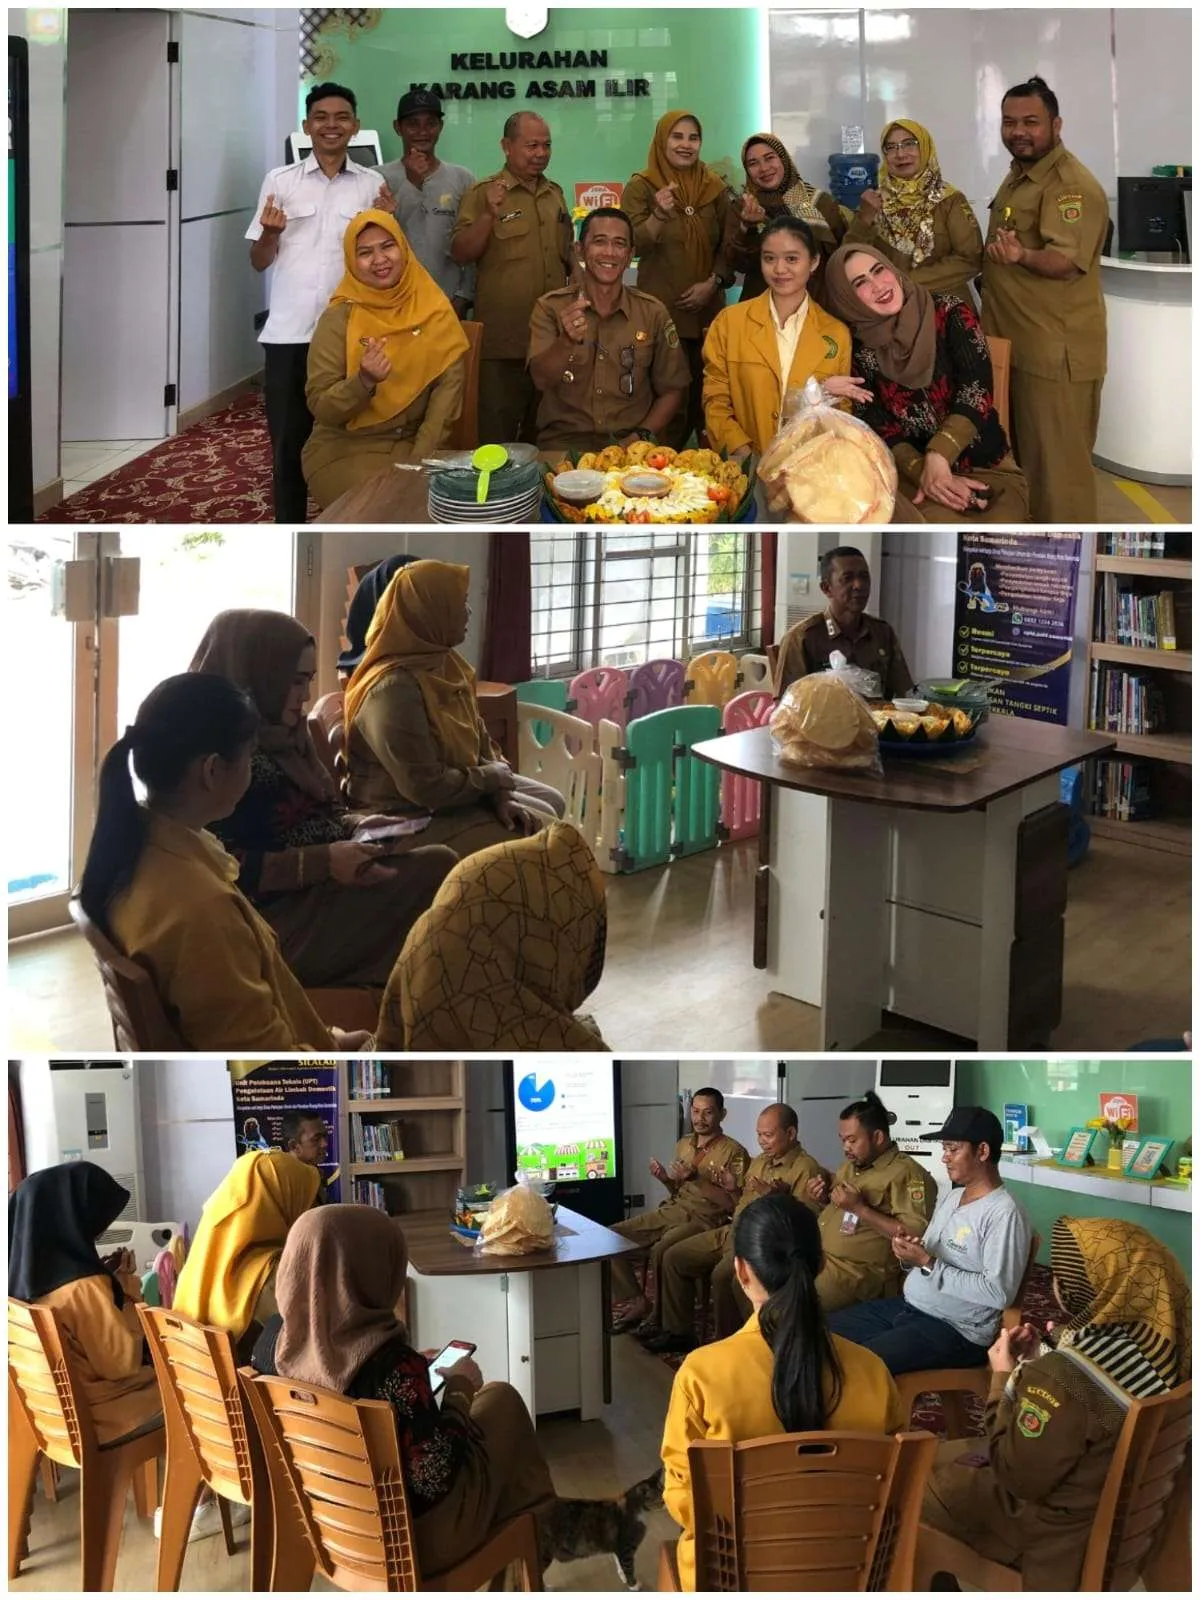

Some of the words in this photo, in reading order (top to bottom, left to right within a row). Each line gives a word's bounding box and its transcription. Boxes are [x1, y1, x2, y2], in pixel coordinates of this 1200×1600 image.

[450, 50, 608, 71] KELURAHAN
[524, 80, 596, 99] ASAM
[604, 78, 651, 98] ILIR
